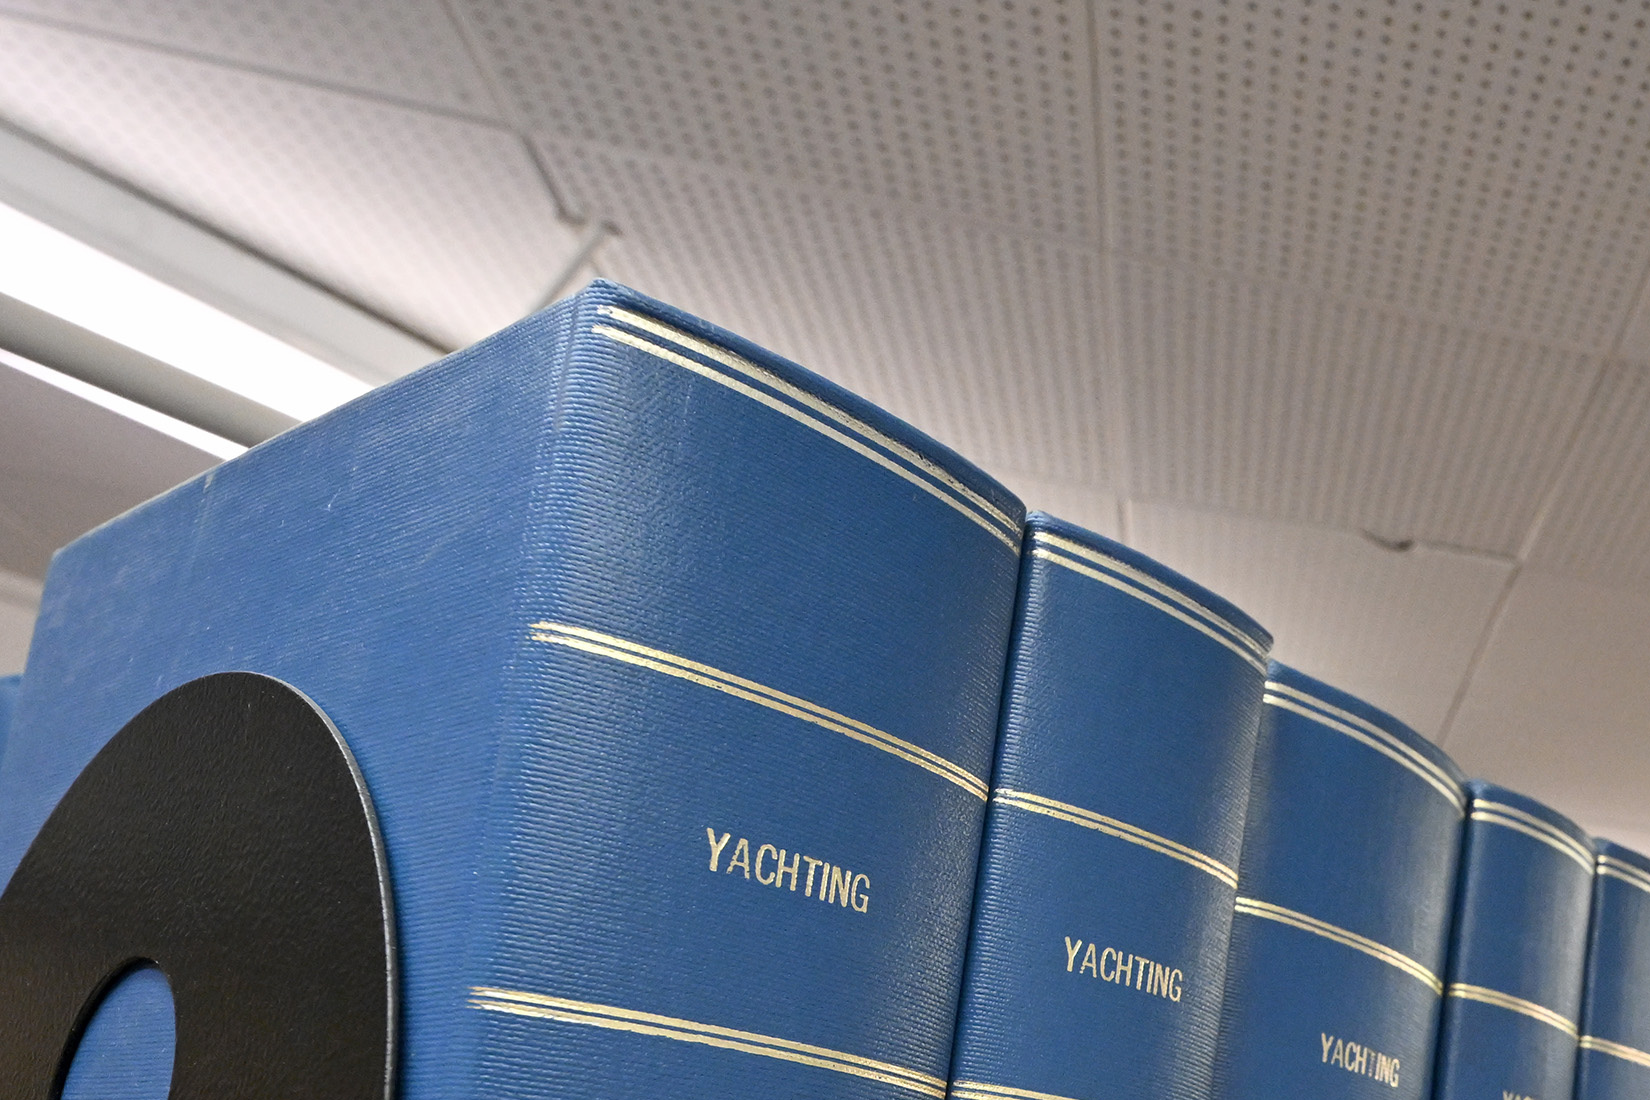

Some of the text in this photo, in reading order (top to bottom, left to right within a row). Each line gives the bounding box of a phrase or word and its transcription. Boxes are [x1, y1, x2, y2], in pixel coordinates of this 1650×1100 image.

[706, 827, 871, 914] YACHTING
[1064, 936, 1184, 1003] YACHTING
[1321, 1032, 1400, 1088] YACHTING
